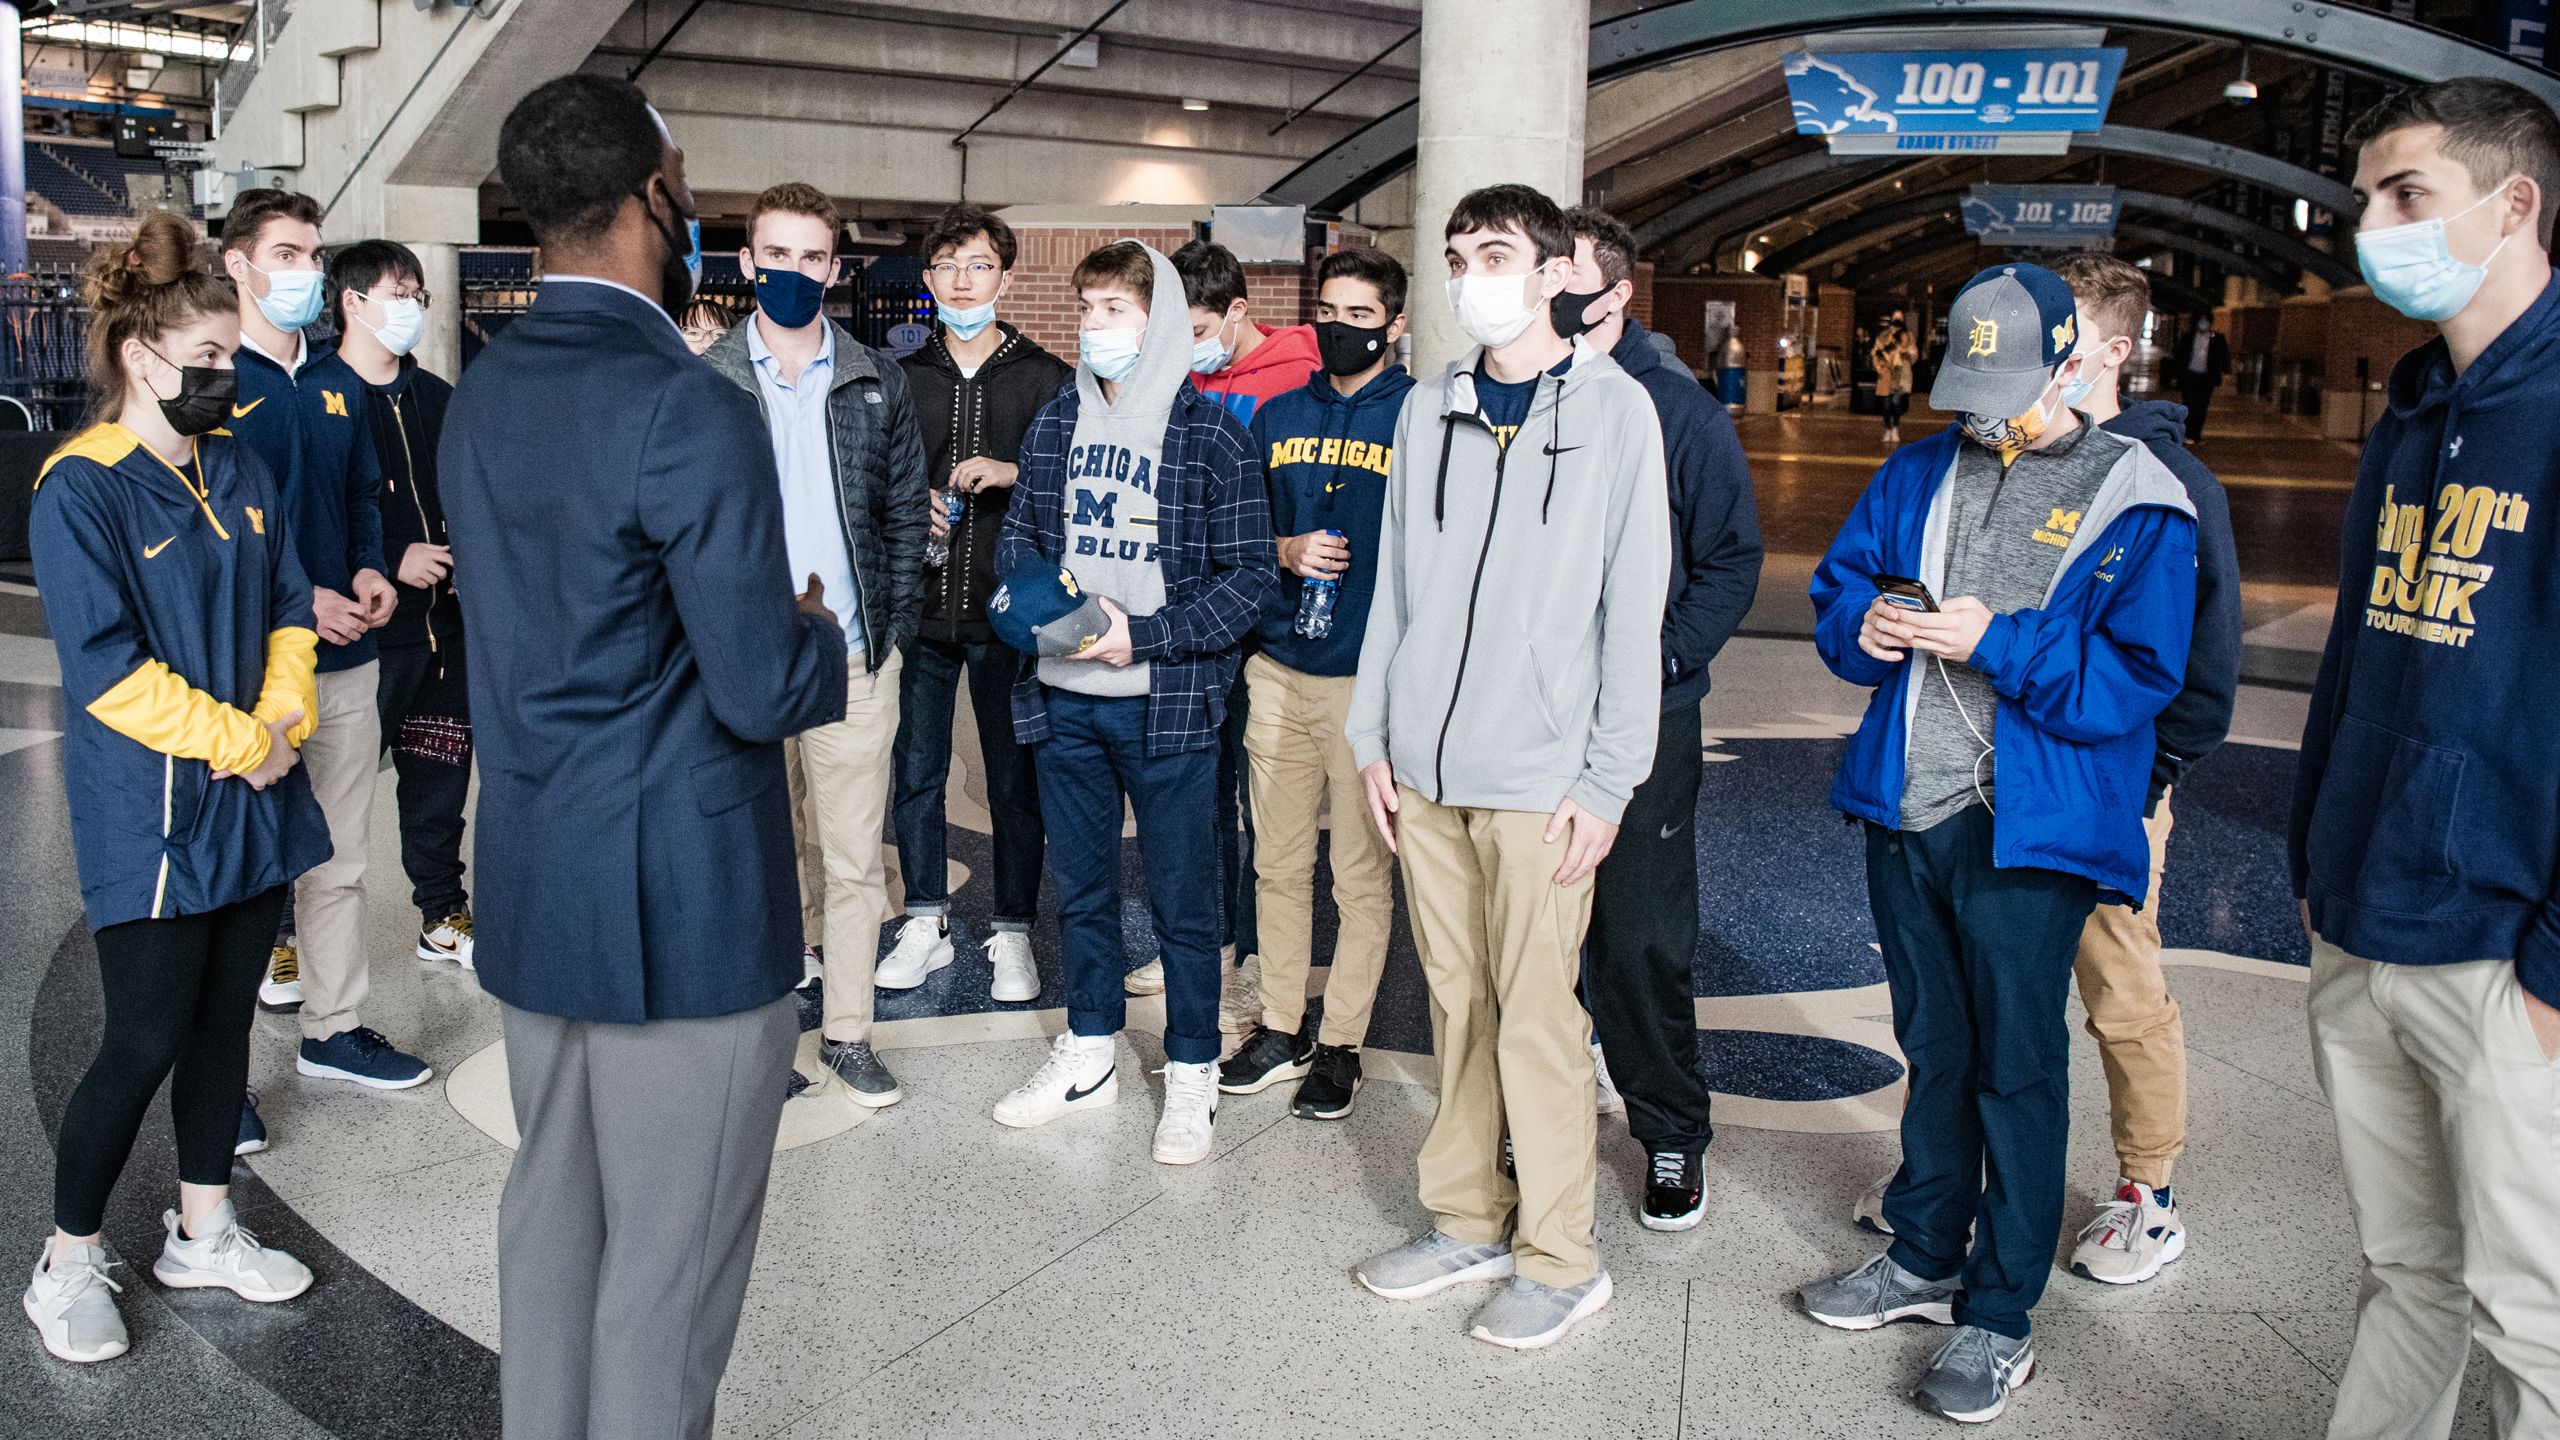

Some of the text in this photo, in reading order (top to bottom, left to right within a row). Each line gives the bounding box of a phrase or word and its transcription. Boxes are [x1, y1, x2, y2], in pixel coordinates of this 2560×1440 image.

[1895, 61, 2100, 105] 100 - 101
[2014, 202, 2113, 223] 101 - 102
[901, 329, 921, 345] 101
[1967, 315, 1999, 359] D
[2052, 314, 2076, 354] M
[321, 390, 349, 417] M
[1068, 444, 1161, 497] CHIGA
[1072, 488, 1118, 528] M
[2045, 507, 2081, 534] M
[2429, 483, 2530, 559] 20th
[2031, 529, 2073, 549] MICHIG
